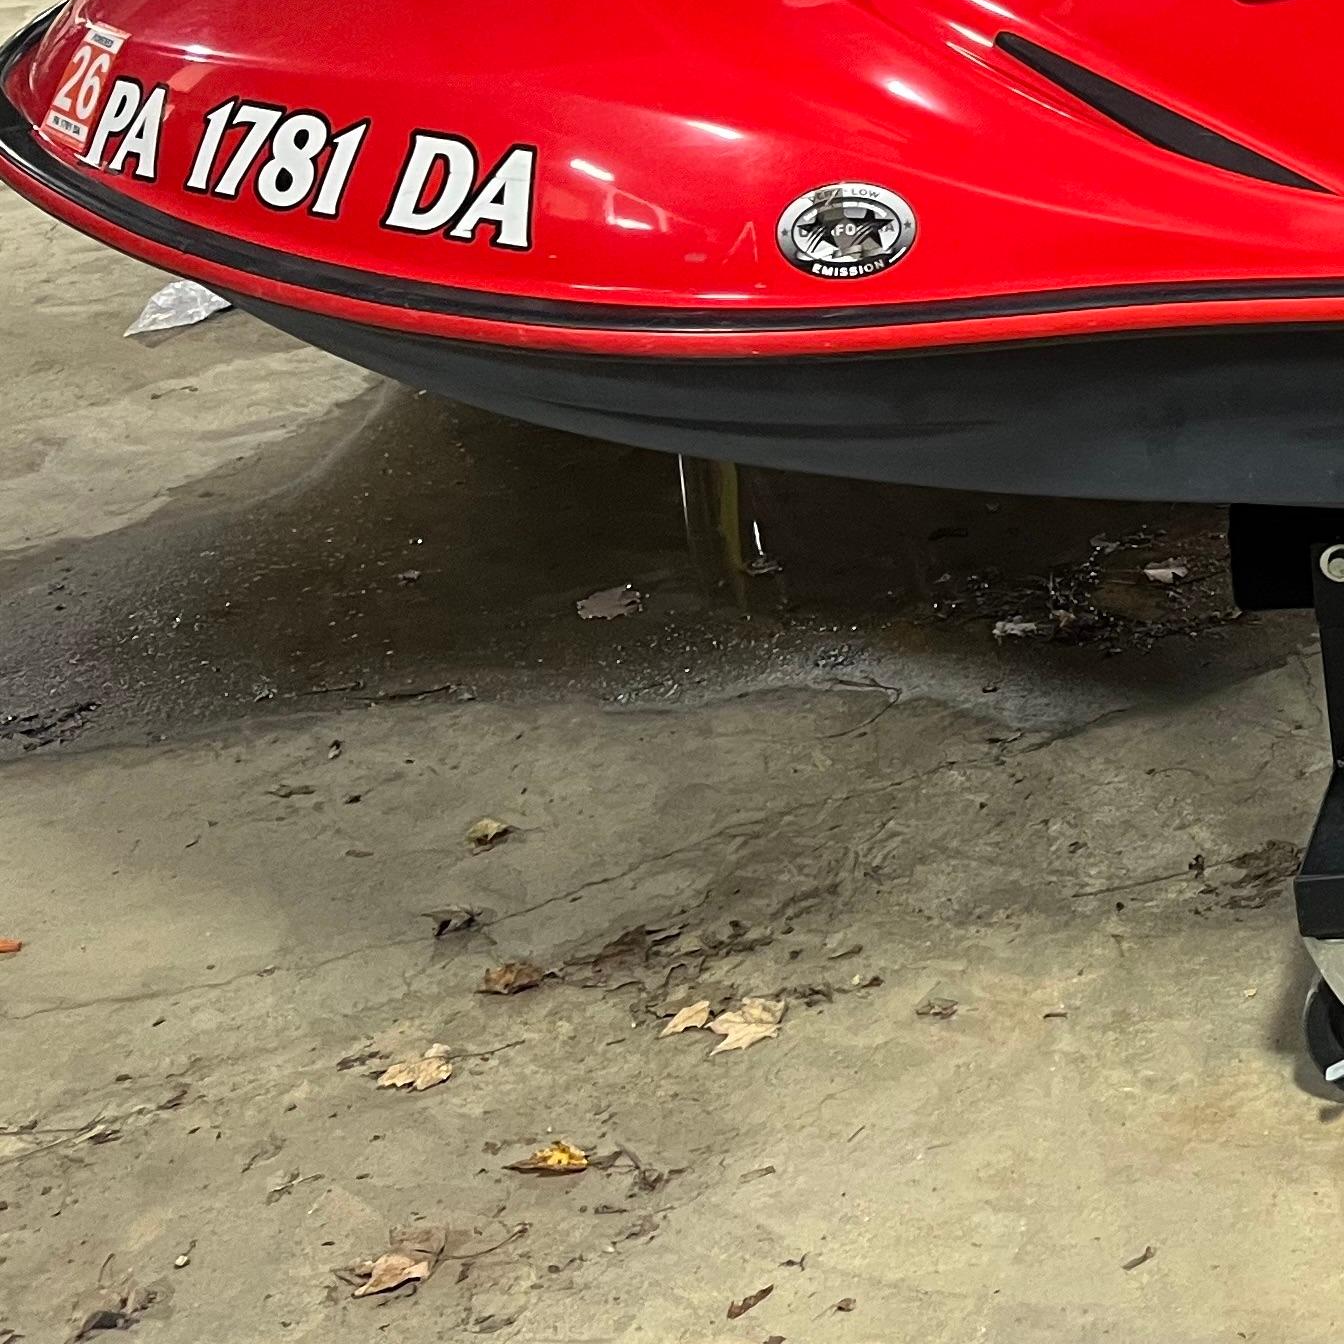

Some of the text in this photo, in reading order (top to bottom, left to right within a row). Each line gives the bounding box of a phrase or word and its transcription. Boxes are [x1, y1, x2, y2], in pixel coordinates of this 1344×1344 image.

[52, 45, 112, 120] 26
[74, 75, 538, 251] PA 1781 DA
[811, 259, 885, 277] EMISSION
